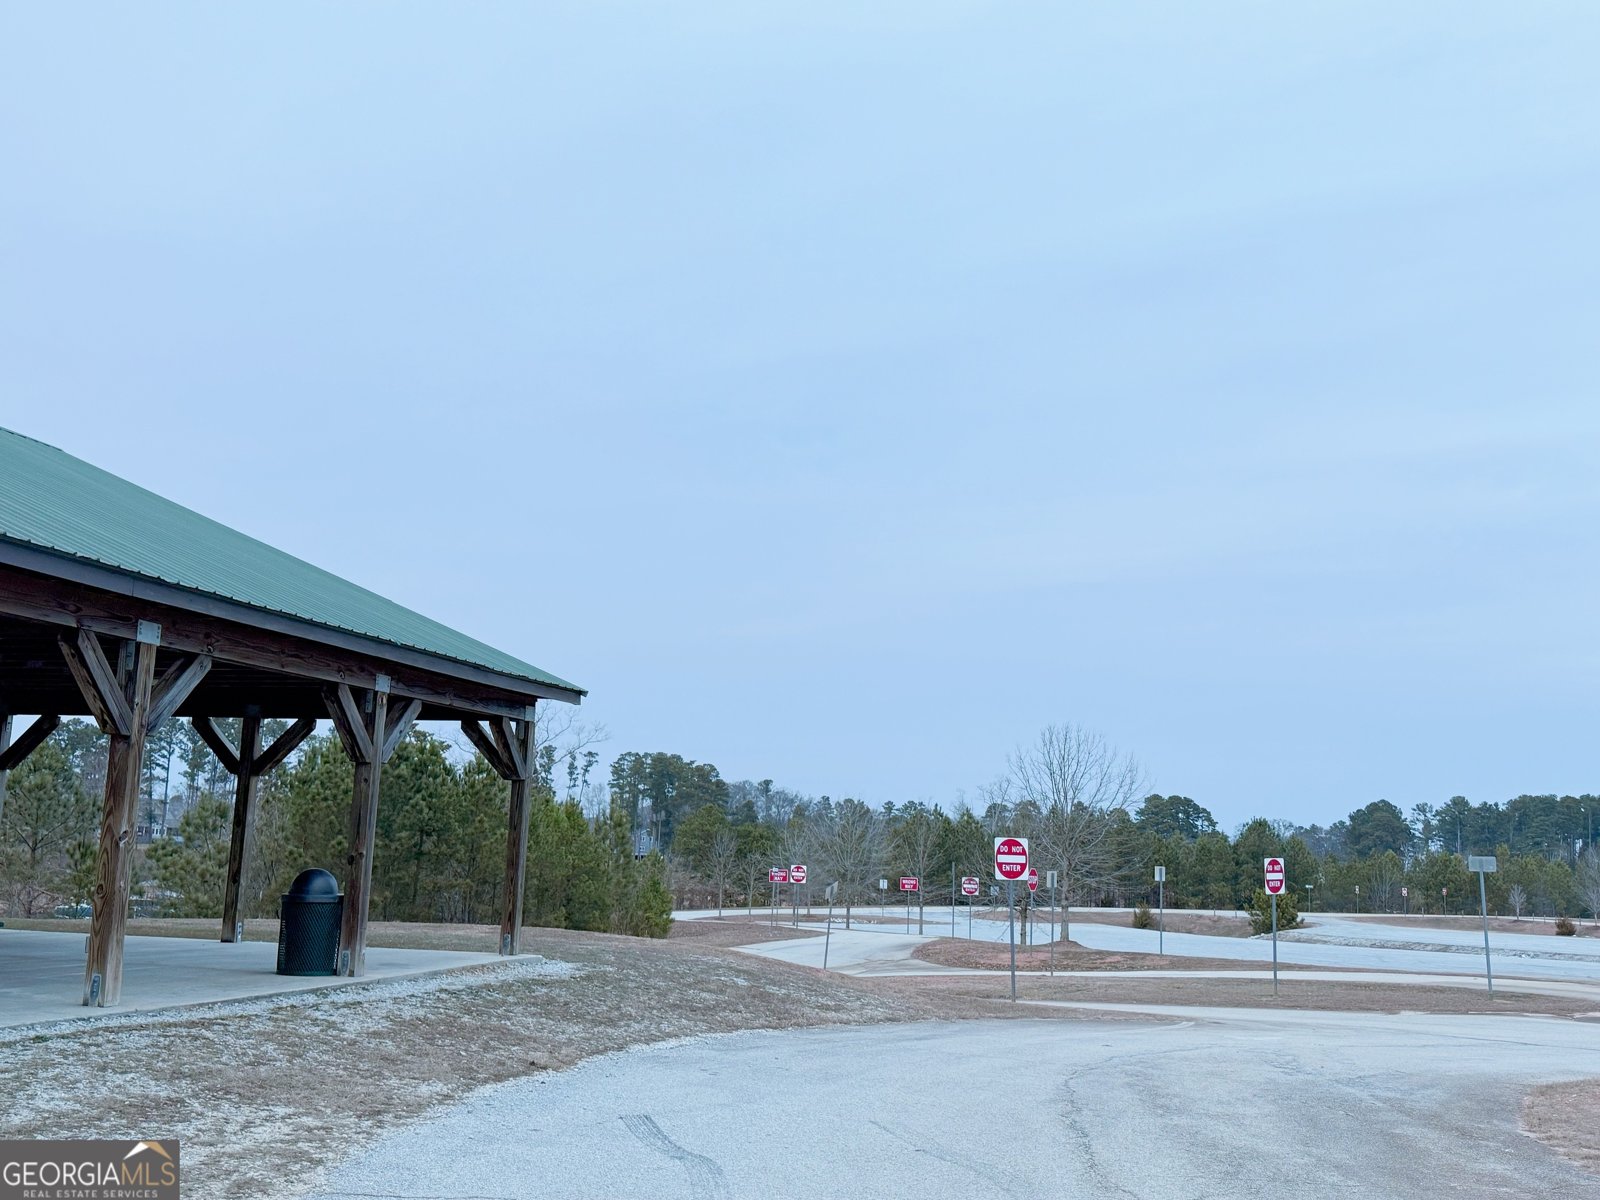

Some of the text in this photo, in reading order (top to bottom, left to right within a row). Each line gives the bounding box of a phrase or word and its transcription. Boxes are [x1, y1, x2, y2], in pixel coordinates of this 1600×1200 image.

[1000, 845, 1023, 853] DO NOT
[1002, 864, 1021, 872] ENTER
